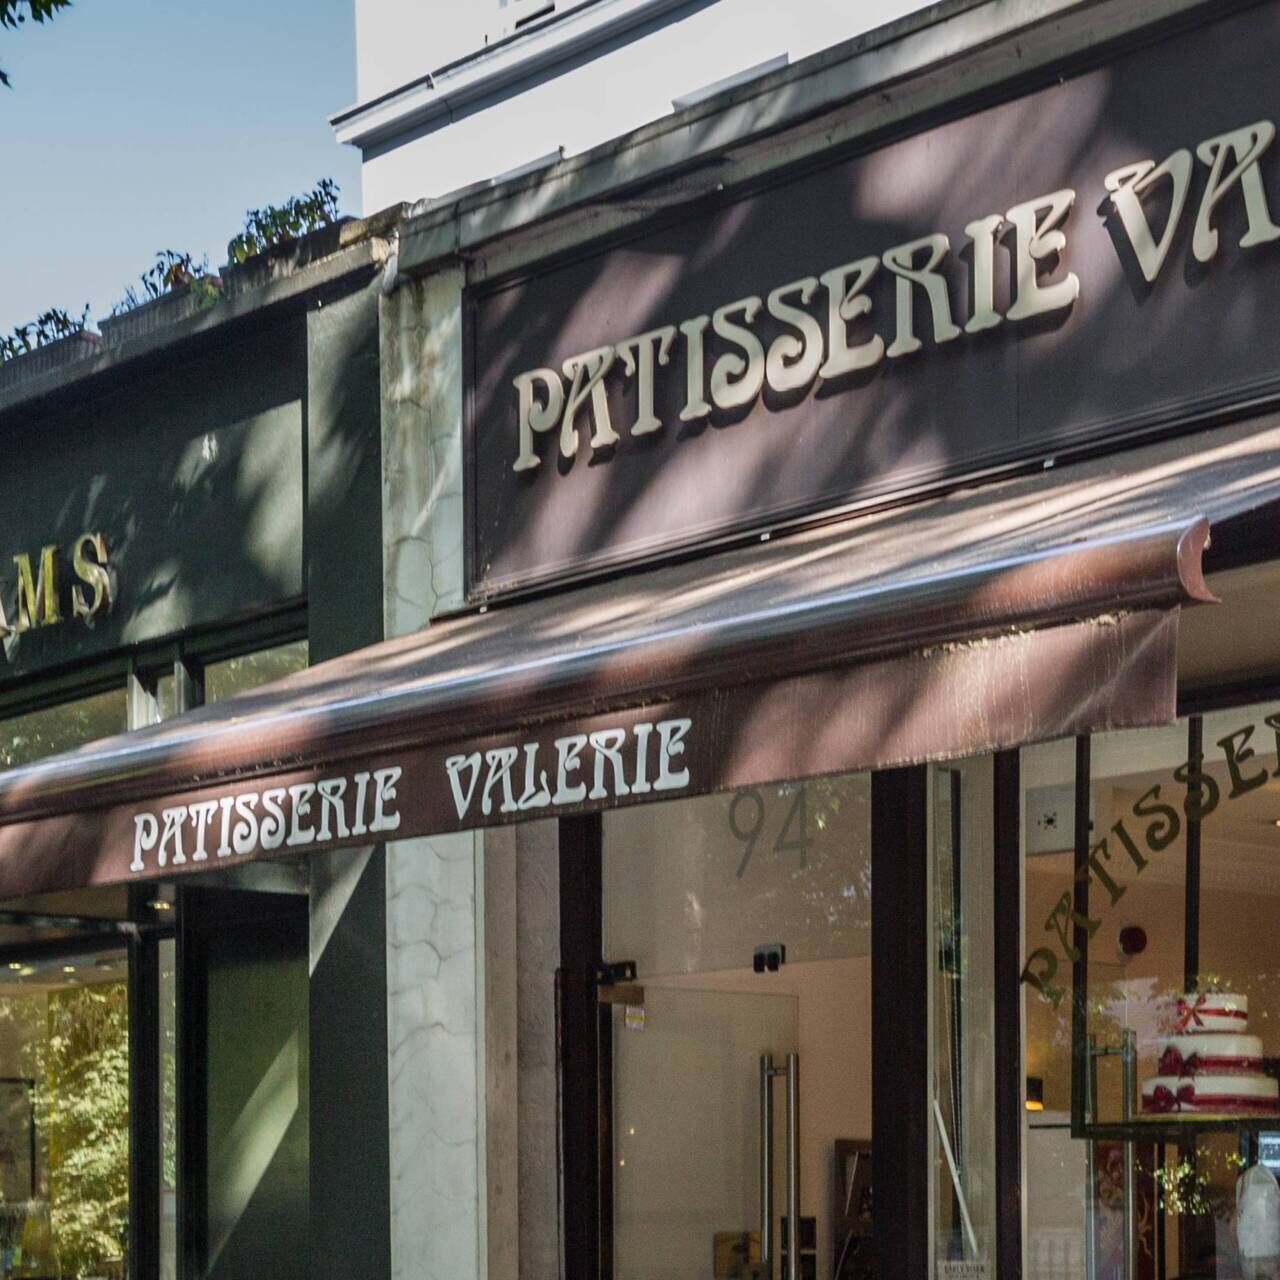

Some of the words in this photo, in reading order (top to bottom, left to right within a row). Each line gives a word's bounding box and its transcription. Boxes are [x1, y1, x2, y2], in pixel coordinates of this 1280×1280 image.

[511, 186, 1081, 474] PATISSERIE
[129, 766, 403, 872] PATISSERIE
[446, 718, 693, 820] VALERIE
[728, 783, 815, 878] 94
